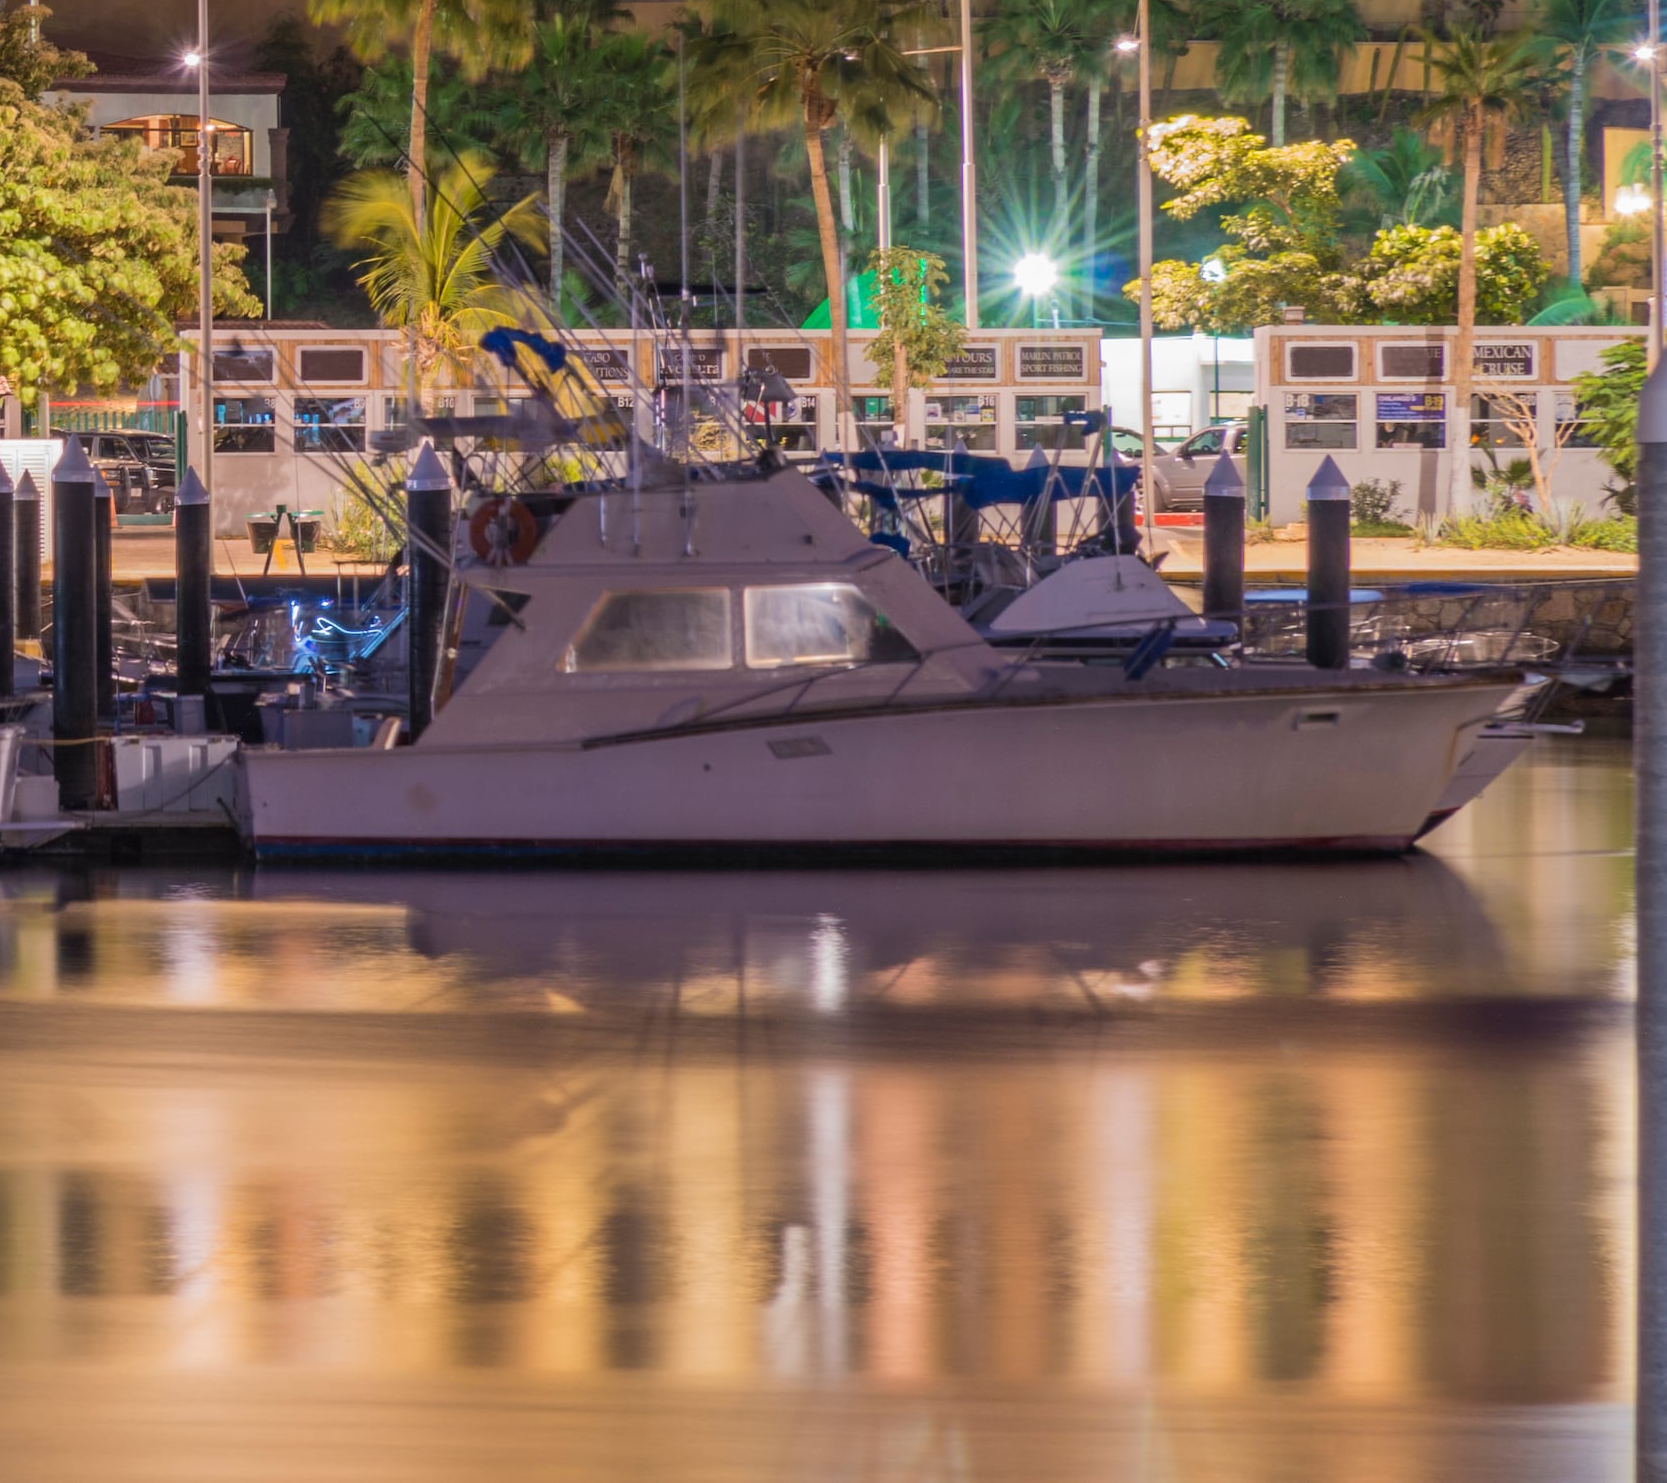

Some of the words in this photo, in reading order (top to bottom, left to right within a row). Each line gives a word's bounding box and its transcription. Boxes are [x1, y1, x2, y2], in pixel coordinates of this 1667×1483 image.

[1473, 346, 1531, 358] MEXICAN
[1021, 364, 1046, 373] SPORT
[1049, 364, 1081, 373] FISHING
[1482, 362, 1525, 375] CRUISE
[438, 398, 454, 408] B10
[618, 397, 635, 408] B12
